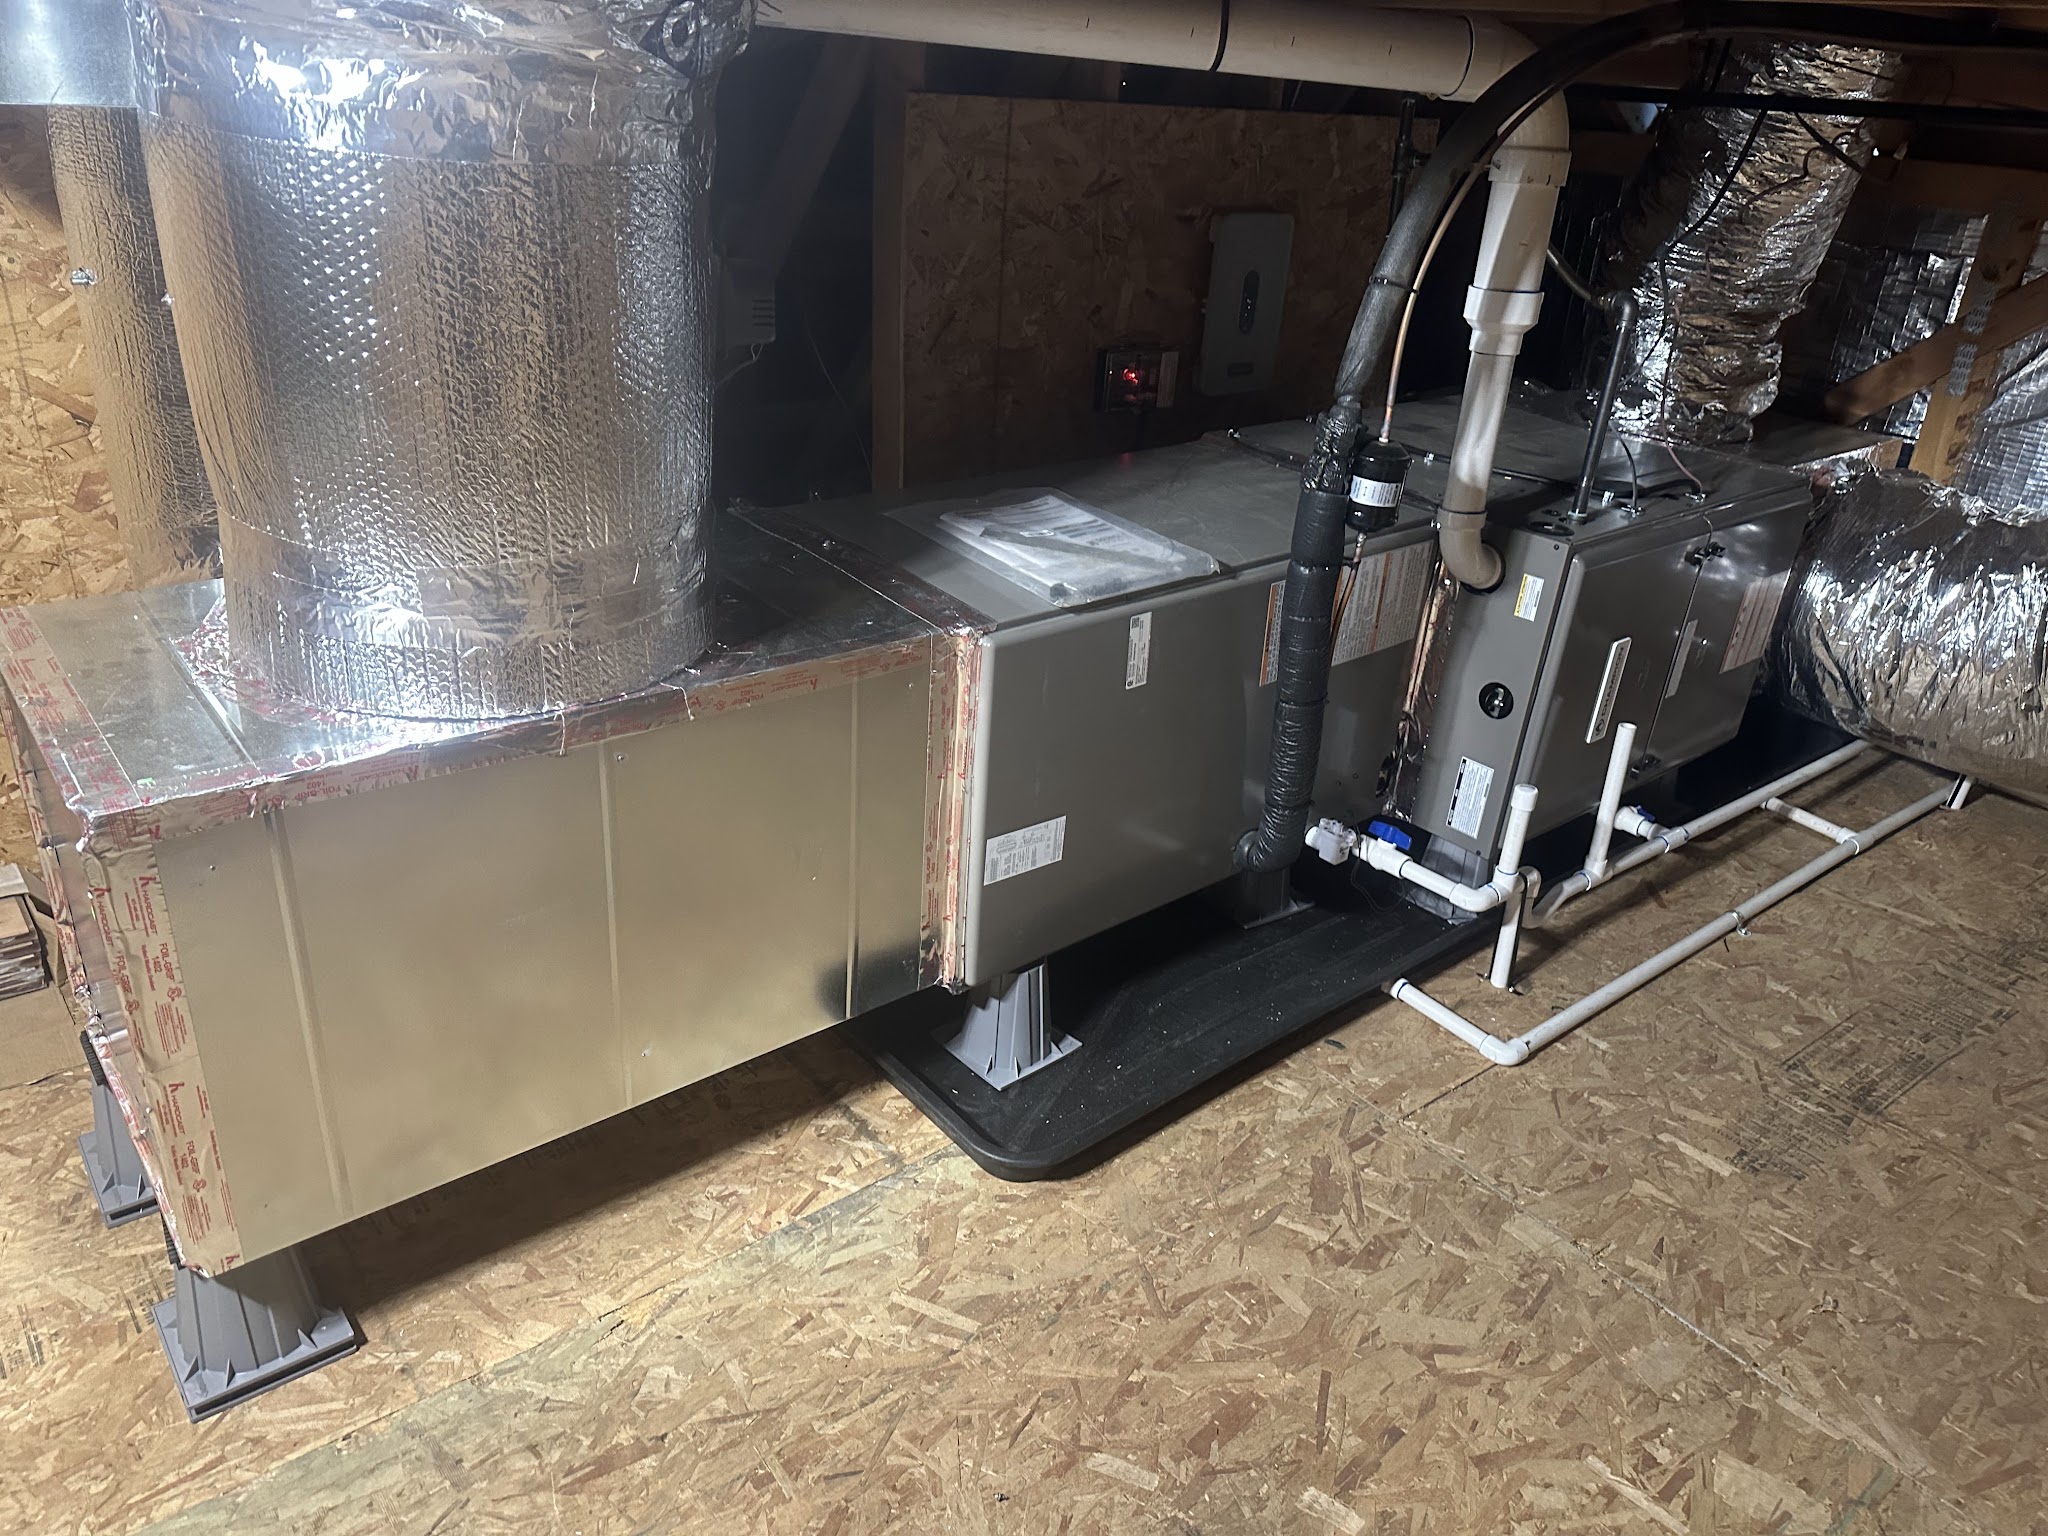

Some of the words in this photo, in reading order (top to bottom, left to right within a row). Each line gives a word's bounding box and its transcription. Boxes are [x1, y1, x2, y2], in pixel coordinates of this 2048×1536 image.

[1602, 647, 1624, 716] CHAMPION
[293, 784, 340, 799] FOIL-GRIP
[305, 779, 326, 789] 1402
[97, 901, 113, 947] HARDCAST
[141, 888, 157, 935] HARDCAST
[116, 956, 132, 994] FOIL-GRIP
[151, 955, 162, 973] 1402
[159, 942, 174, 981] FOIL-GRIP
[171, 1094, 185, 1135] HARDCAST
[179, 1153, 188, 1168] 1402
[185, 1140, 199, 1174] FOIL-GRIP
